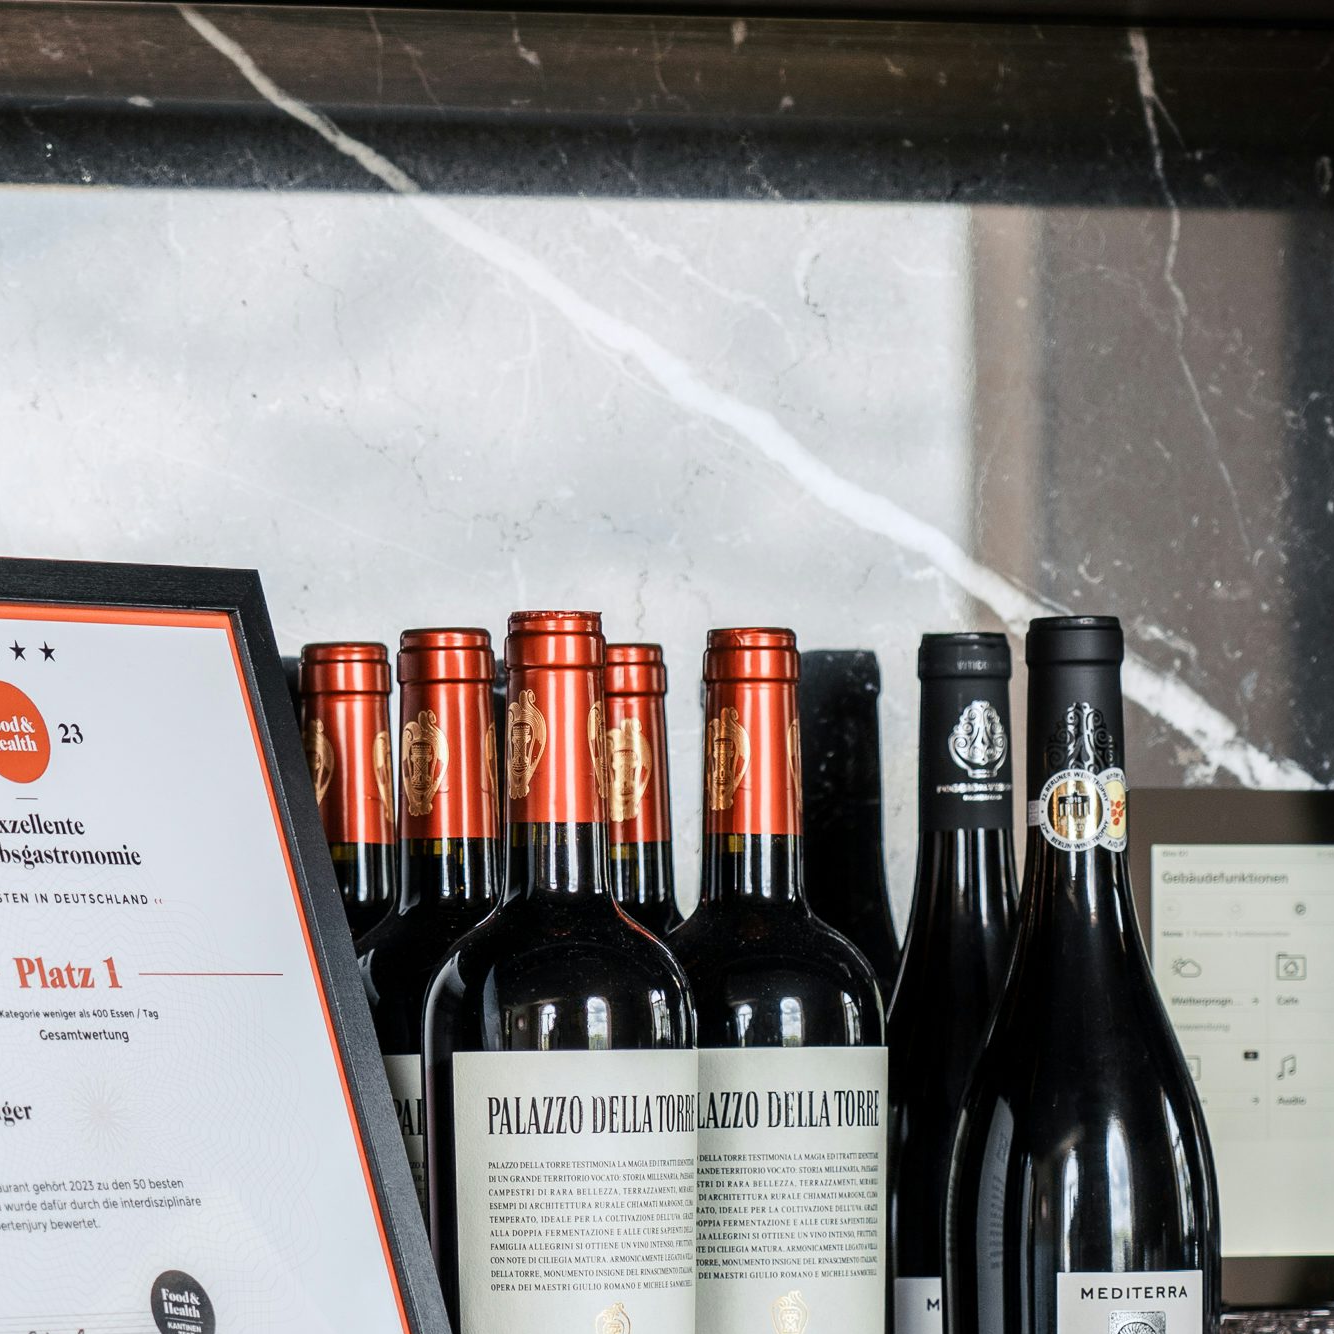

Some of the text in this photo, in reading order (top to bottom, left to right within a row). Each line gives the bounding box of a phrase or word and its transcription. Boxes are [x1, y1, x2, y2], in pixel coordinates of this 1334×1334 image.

[58, 723, 83, 744] 23
[1162, 872, 1288, 885] Gebäudefunktionen
[35, 893, 49, 904] IN
[55, 894, 148, 905] DEUTSCHLAND
[12, 957, 122, 989] Platz 1
[0, 1010, 40, 1020] Kategorie
[43, 1010, 76, 1020] weniger
[79, 1009, 90, 1018] als
[93, 1009, 108, 1018] 400
[111, 1009, 134, 1018] Essen
[143, 1009, 159, 1020] Tag
[40, 1029, 129, 1042] Gesamtwertung
[487, 1094, 695, 1136] PALAZZO DELLA TORRE
[697, 1088, 879, 1130] LAZZO DELLA TORRE
[489, 1175, 496, 1183] DI
[33, 1180, 67, 1195] gehört
[69, 1180, 94, 1191] 2023
[97, 1182, 109, 1191] zu
[112, 1179, 130, 1190] den
[133, 1178, 146, 1190] 50
[149, 1177, 184, 1189] besten
[5, 1200, 37, 1212] wurde
[40, 1199, 67, 1211] dafür
[71, 1198, 100, 1210] durch
[103, 1198, 119, 1209] die
[121, 1195, 201, 1210] interdisziplinäre
[490, 1202, 516, 1210] ESEMPI
[490, 1216, 538, 1224] TEMPERATO,
[605, 1214, 654, 1222] COLTIVAZIONE
[1081, 1286, 1188, 1299] MEDITERRA
[164, 1301, 200, 1318] Health
[168, 1321, 201, 1332] KANTINEN
